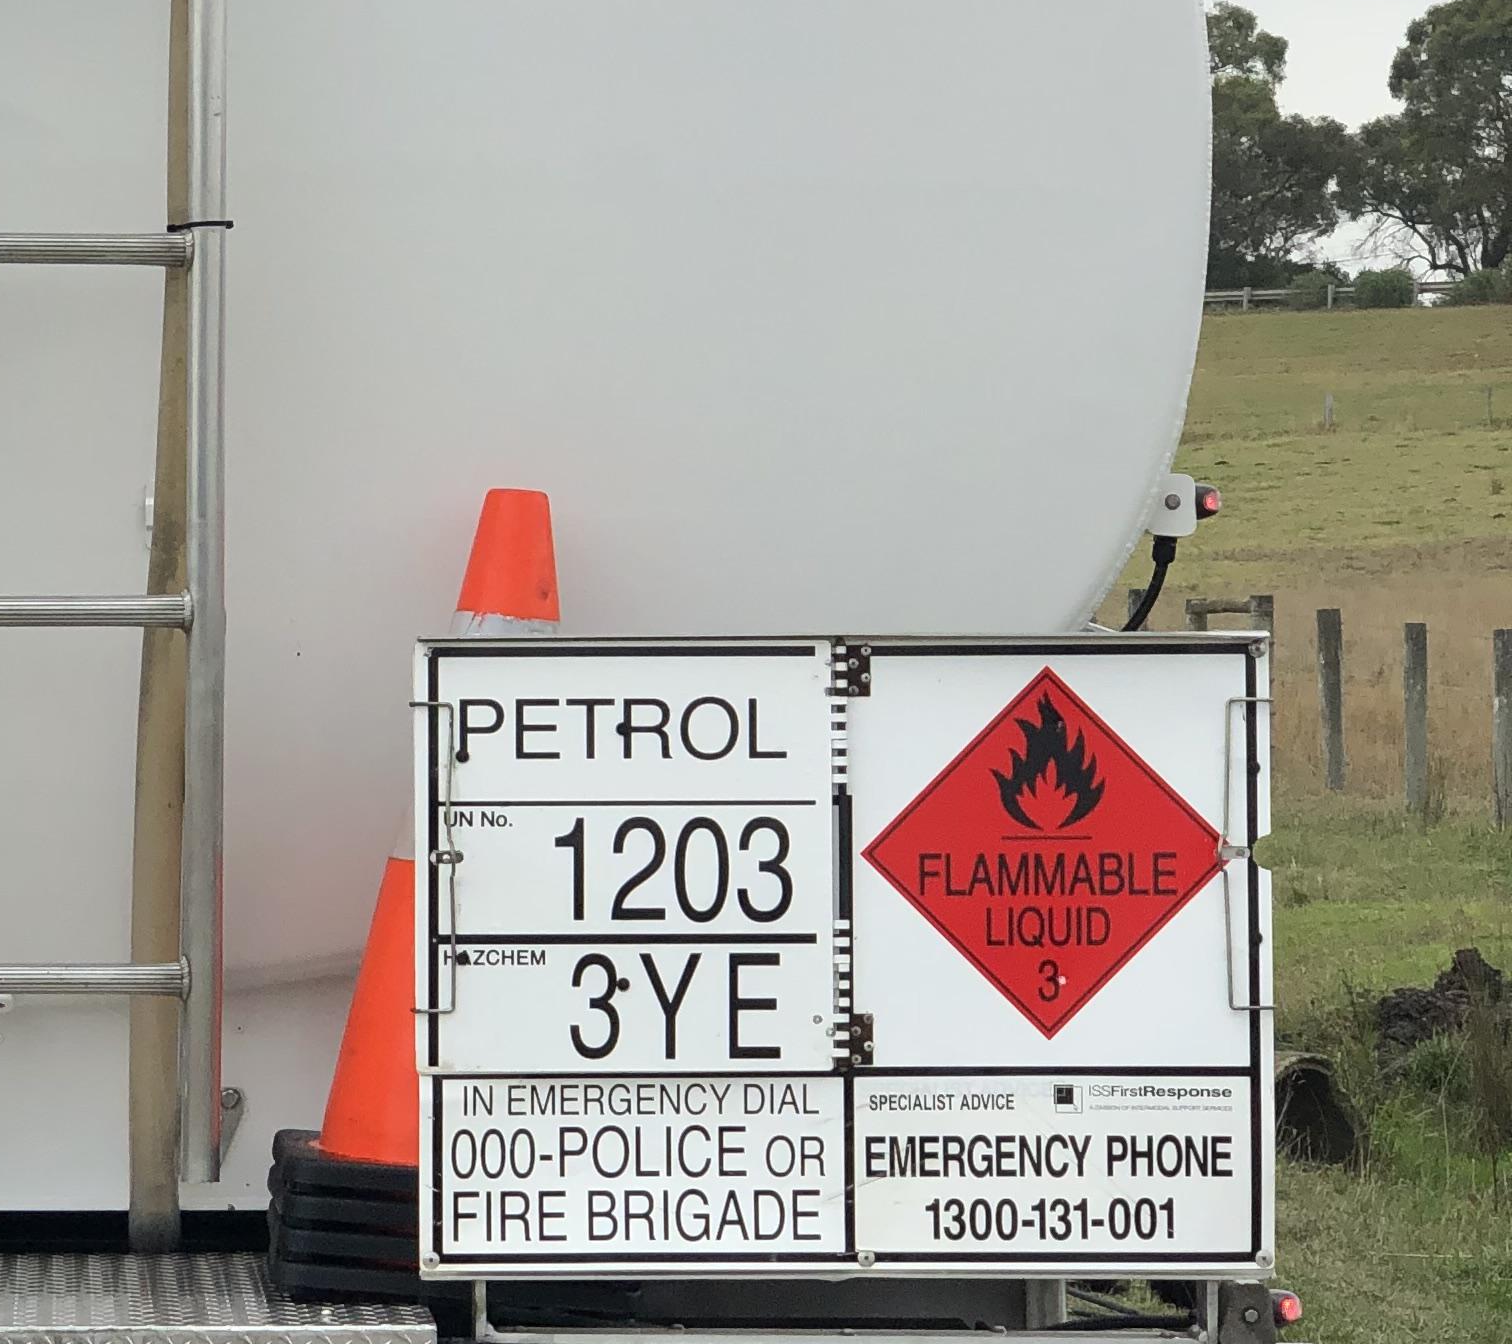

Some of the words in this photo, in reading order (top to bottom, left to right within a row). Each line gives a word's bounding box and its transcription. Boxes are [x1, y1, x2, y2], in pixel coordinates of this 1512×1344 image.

[456, 697, 787, 763] PETROL
[443, 810, 473, 828] UN
[480, 810, 513, 828] No.
[554, 816, 793, 923] 1203
[918, 852, 1178, 897] FLAMMABLE
[986, 906, 1111, 949] LIQUID
[1038, 959, 1061, 1003] 3
[462, 1085, 494, 1116] IN
[507, 1083, 732, 1116] EMERGENCY
[743, 1083, 820, 1115] DIAL
[869, 1093, 954, 1111] SPECIALIST
[960, 1093, 1016, 1110] ADVICE
[451, 1124, 748, 1179] 000-POLICE
[765, 1135, 826, 1178] OR
[865, 1134, 1092, 1178] EMERGENCY
[1106, 1134, 1233, 1178] PHONE
[453, 1190, 568, 1242] FIRE
[588, 1188, 822, 1242] BRIGADE
[925, 1197, 1175, 1241] 1300-131-001
